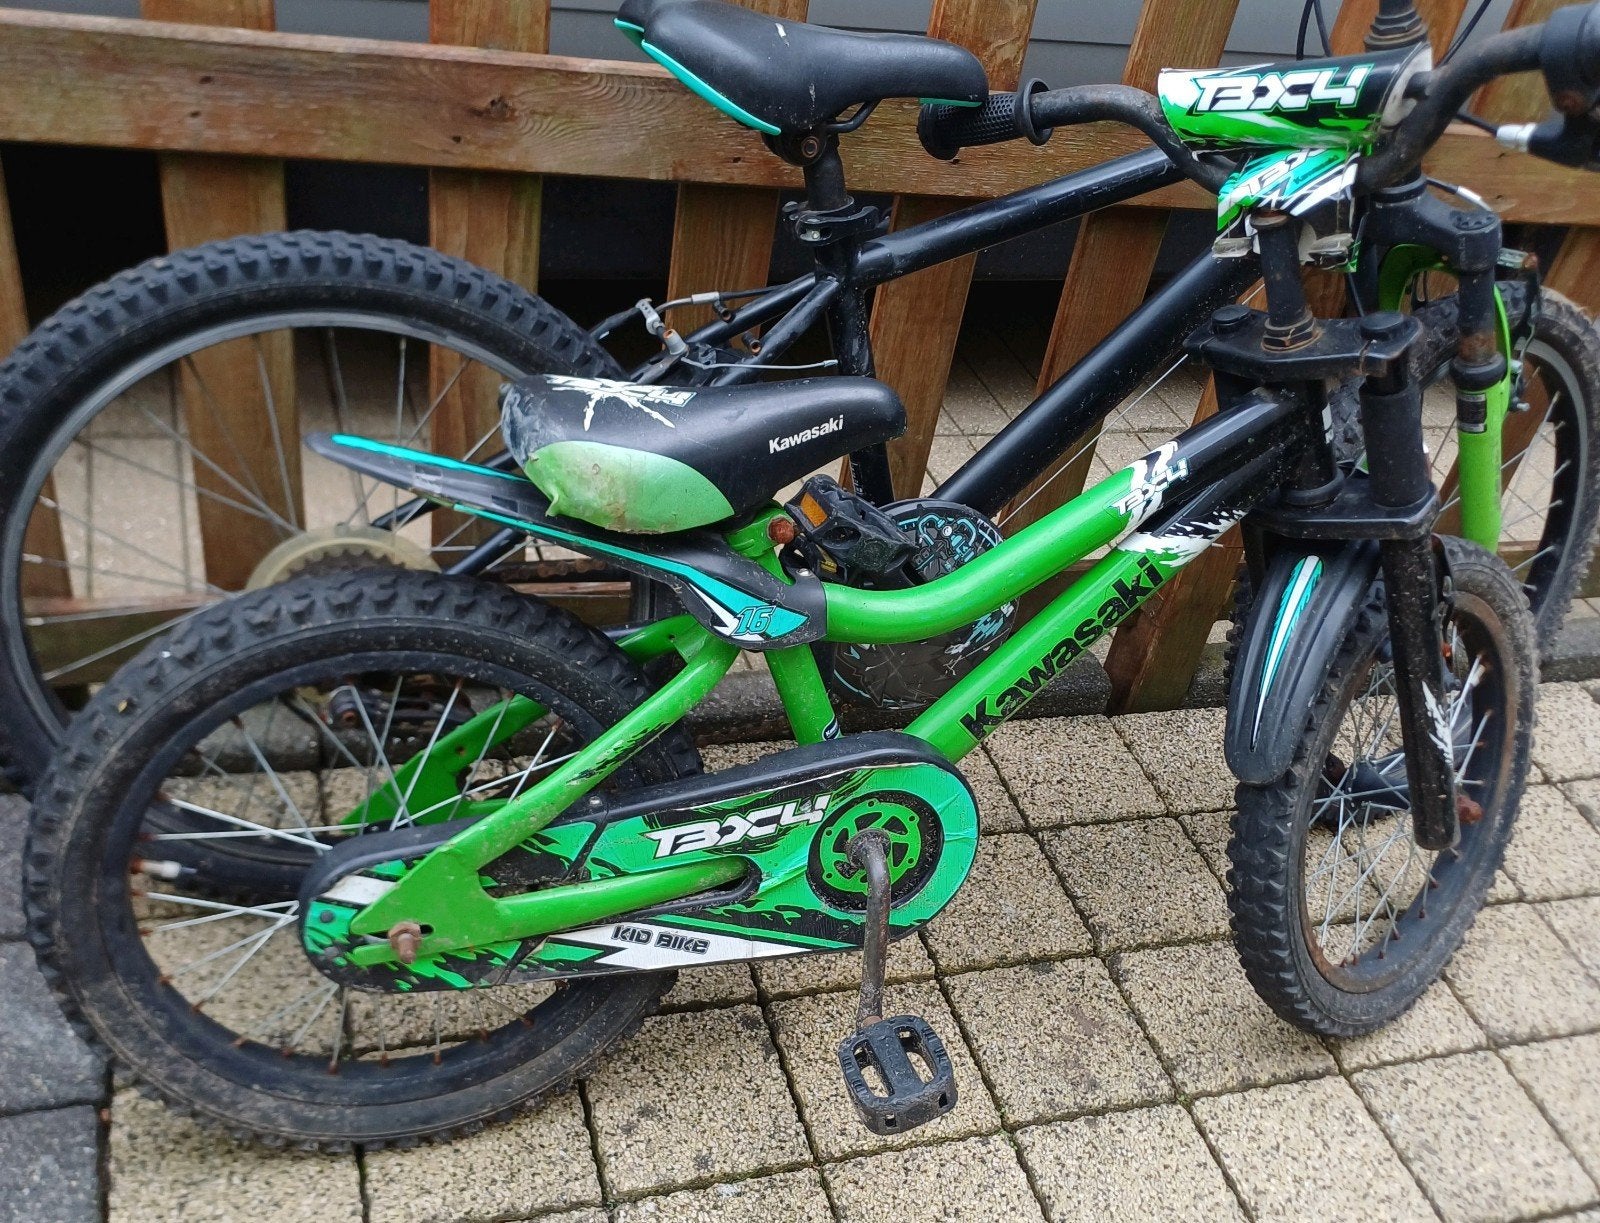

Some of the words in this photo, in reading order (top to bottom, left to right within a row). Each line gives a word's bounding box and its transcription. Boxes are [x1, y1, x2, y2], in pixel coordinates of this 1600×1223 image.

[1192, 64, 1374, 113] BX4
[768, 415, 844, 454] Kawasaki
[1107, 457, 1189, 516] BX4
[731, 605, 775, 636] 16
[959, 555, 1165, 742] Kawasaki
[643, 795, 831, 859] BX4
[611, 924, 653, 945] KID
[654, 932, 709, 955] BIKE
